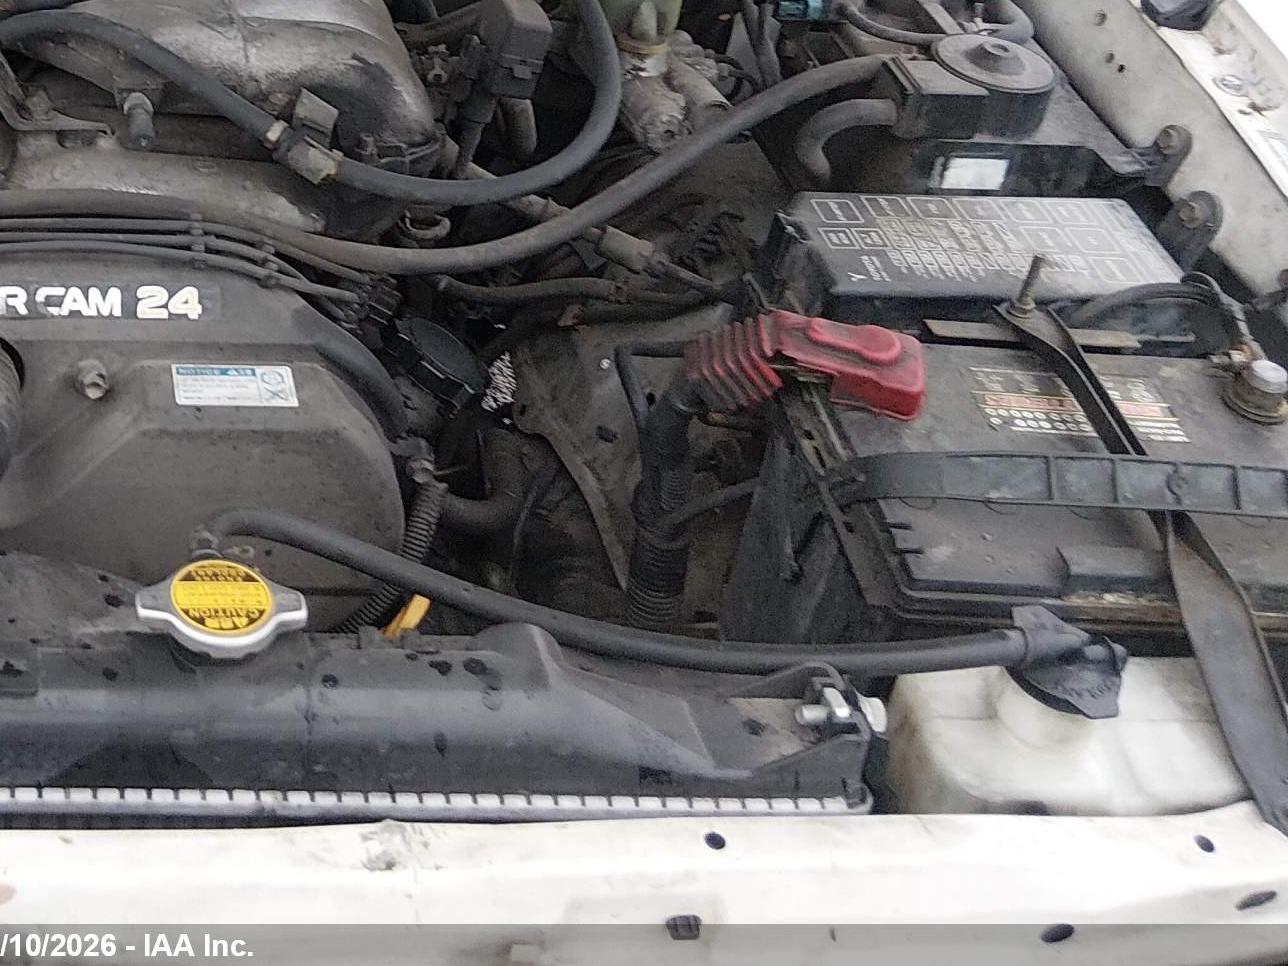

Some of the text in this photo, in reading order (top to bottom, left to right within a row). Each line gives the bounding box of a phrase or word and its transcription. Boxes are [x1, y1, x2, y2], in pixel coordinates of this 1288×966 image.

[35, 285, 122, 317] CAM
[136, 285, 202, 320] 24
[188, 607, 260, 619] CAUTION
